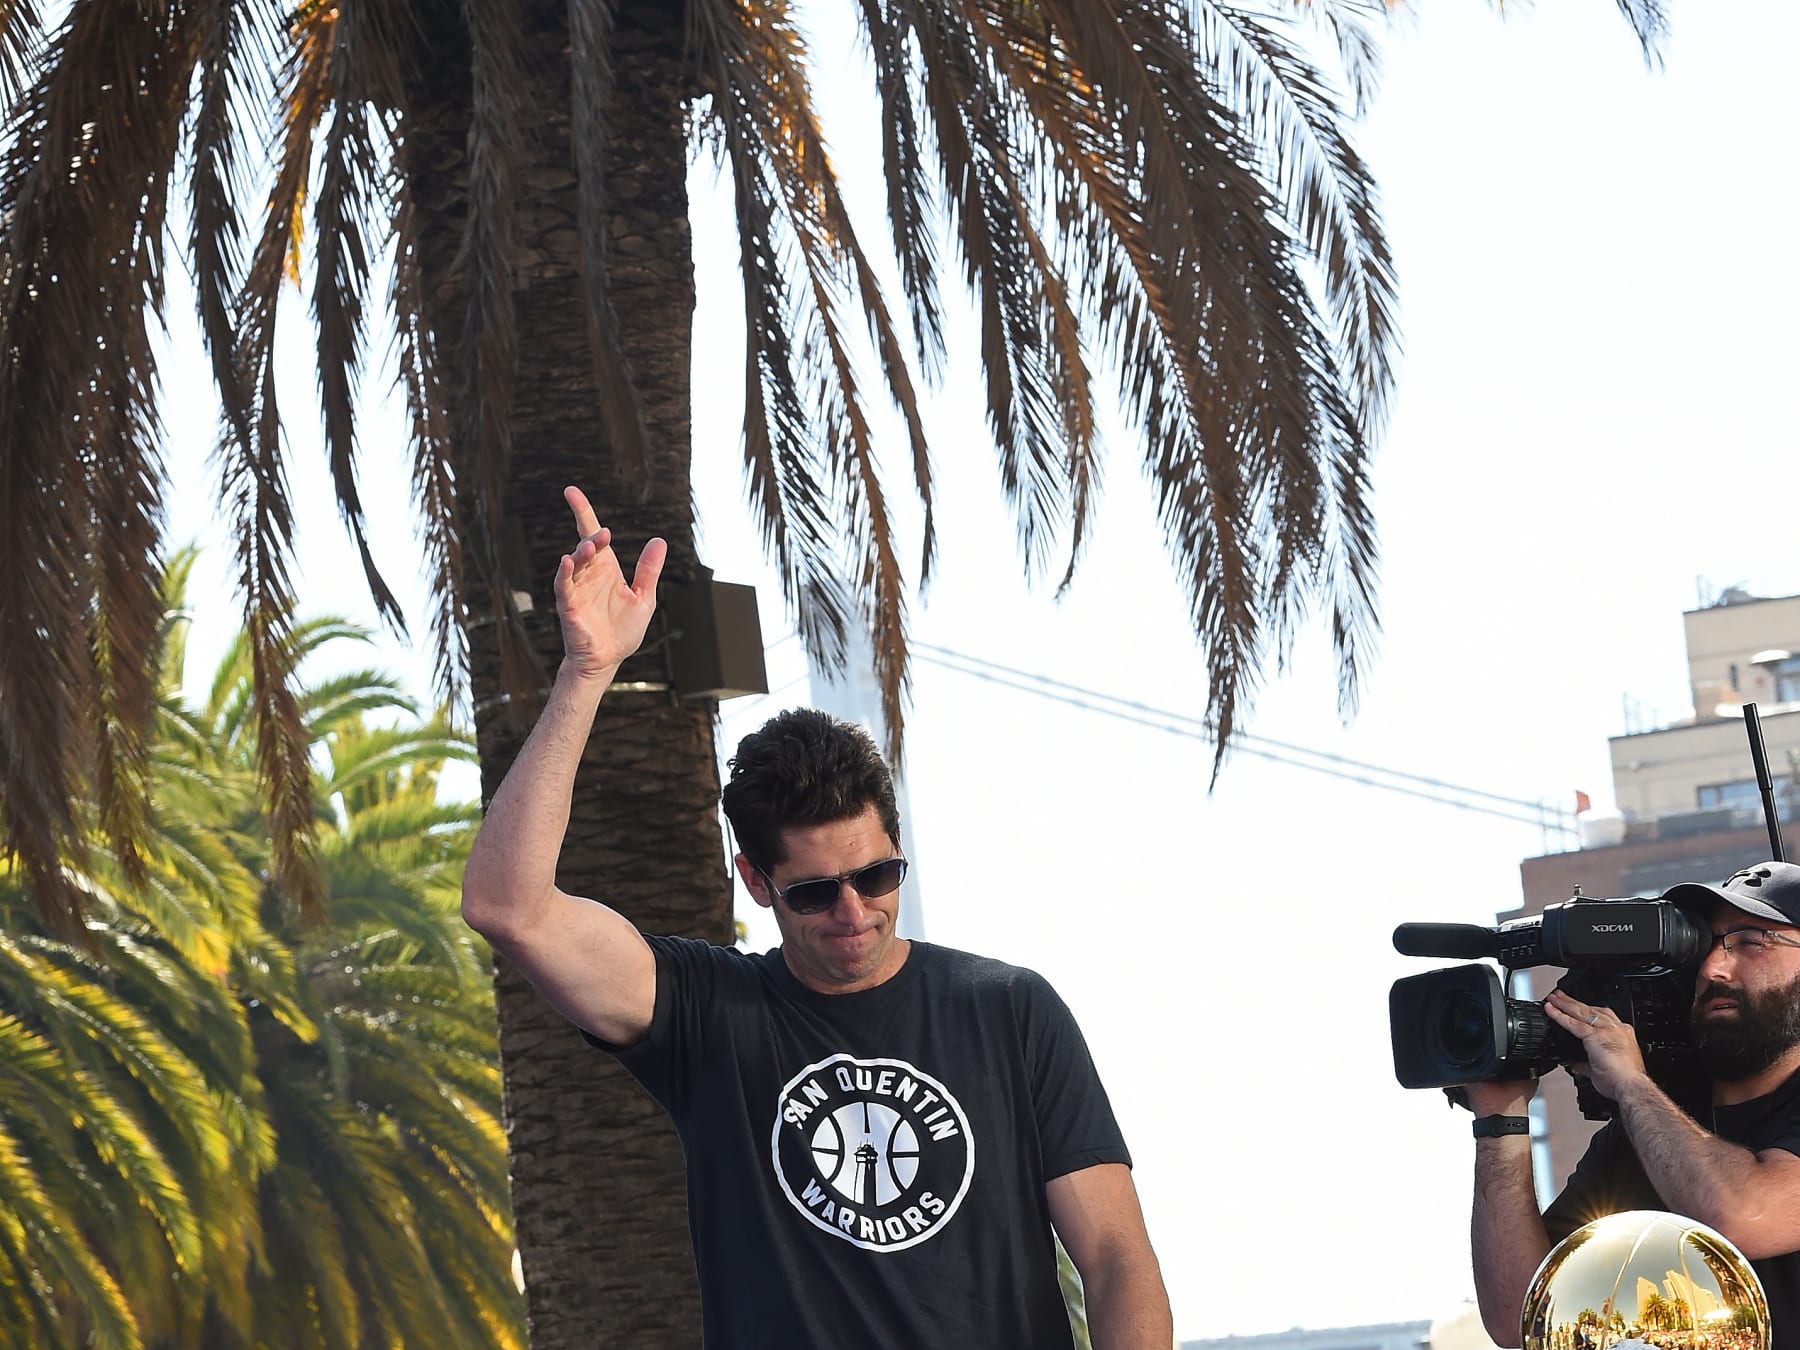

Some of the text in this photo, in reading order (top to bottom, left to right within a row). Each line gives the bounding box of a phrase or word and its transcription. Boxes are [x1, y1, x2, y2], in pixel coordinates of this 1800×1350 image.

[1591, 924, 1634, 932] XDCAM
[783, 1066, 959, 1142] SAN QUENTIN
[801, 1177, 946, 1243] WARRIORS
